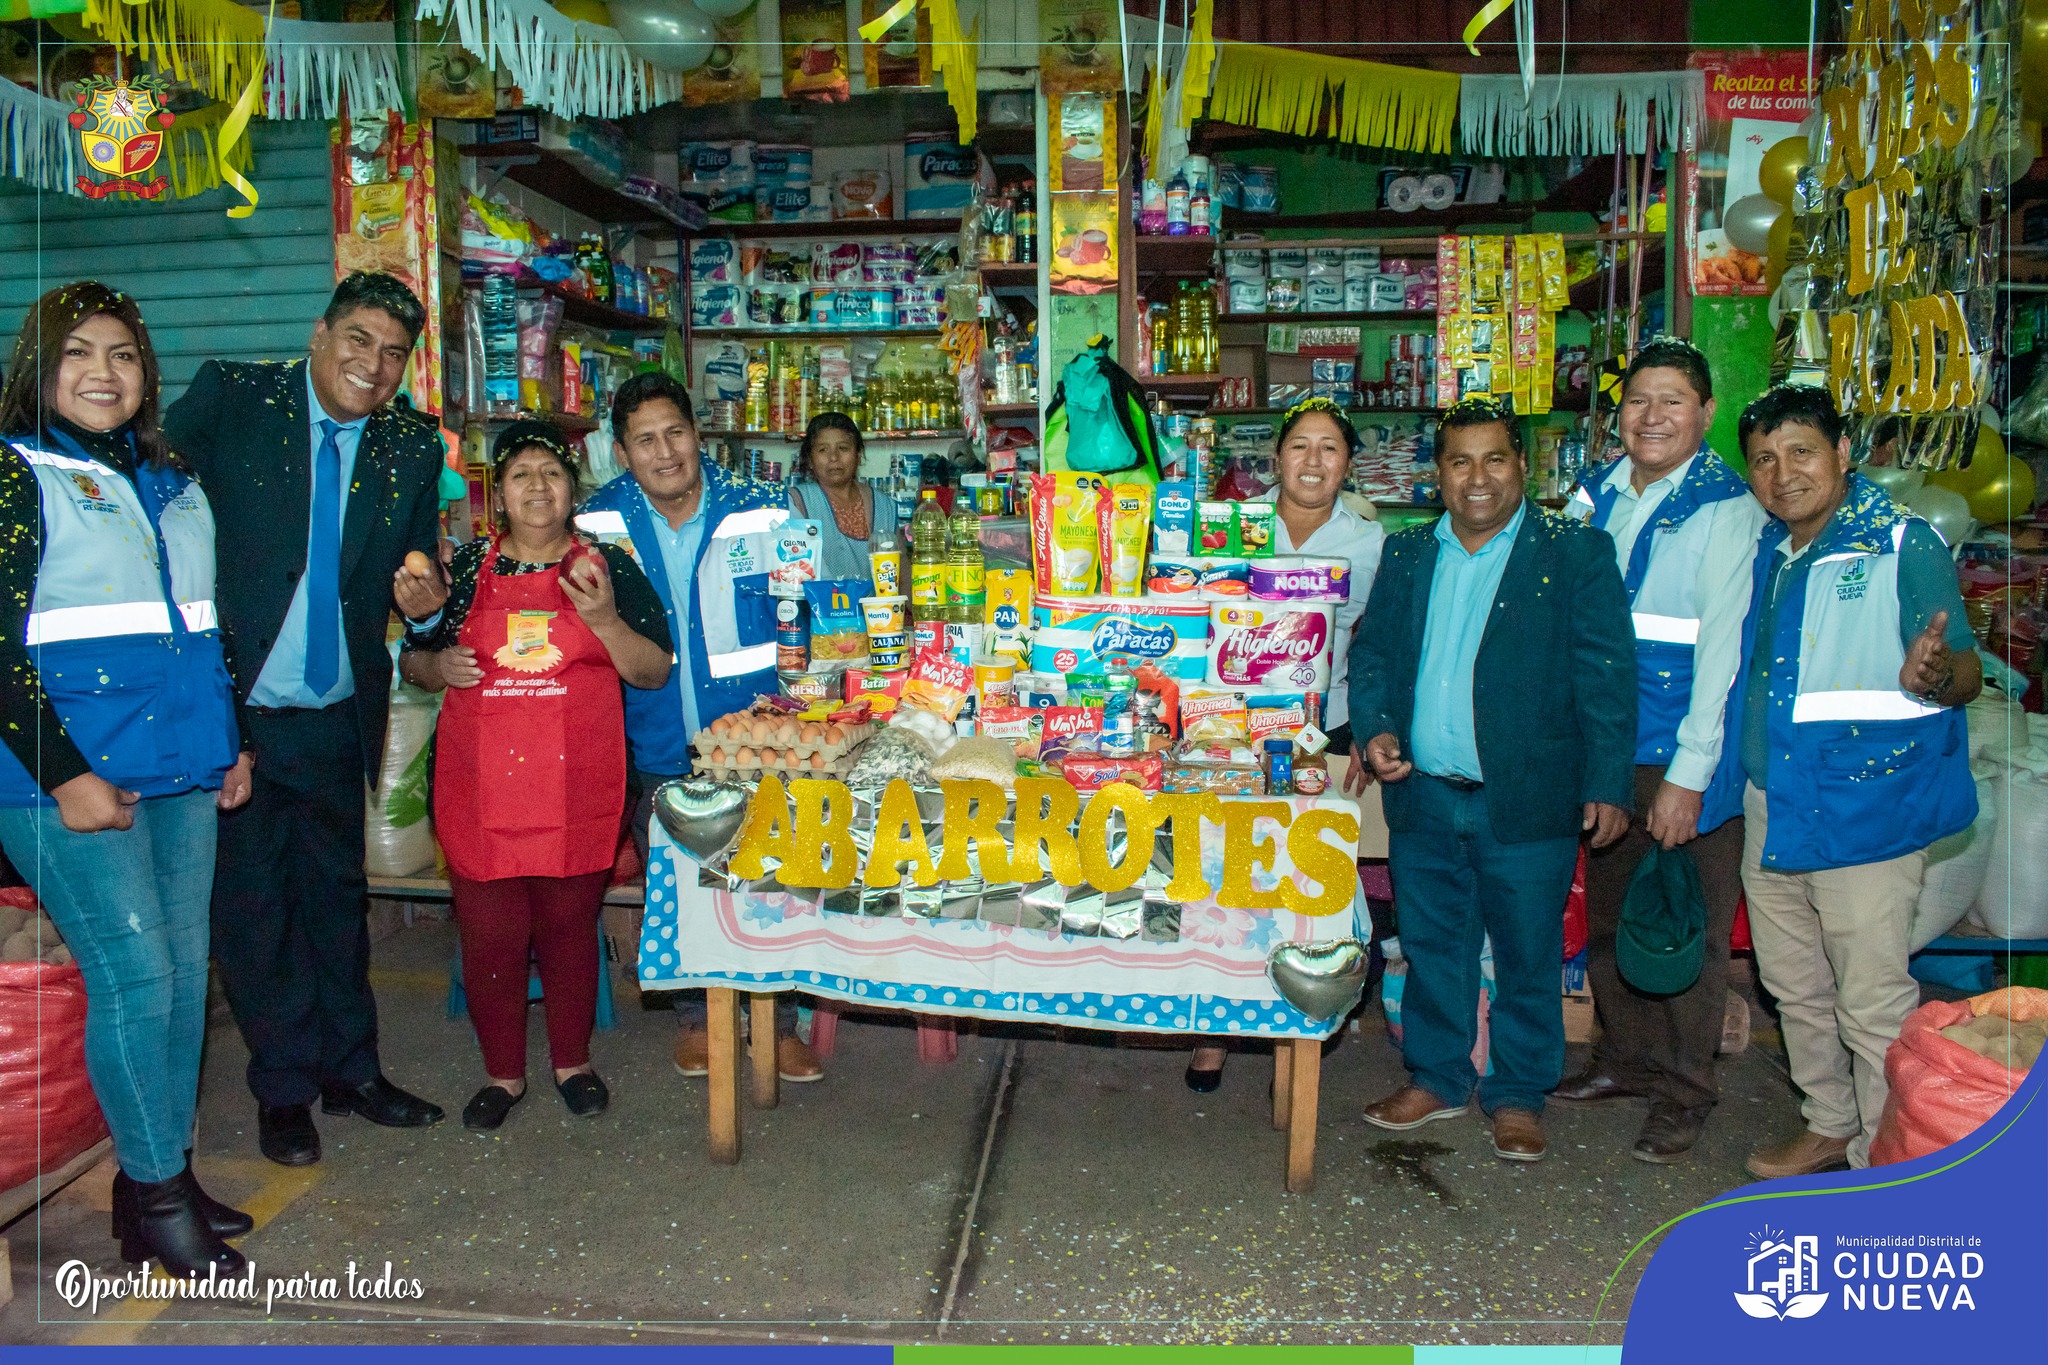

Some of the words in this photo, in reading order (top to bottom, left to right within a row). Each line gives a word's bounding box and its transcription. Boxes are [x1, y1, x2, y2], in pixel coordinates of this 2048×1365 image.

[1713, 74, 1774, 92] Realza
[1779, 74, 1796, 92] el
[1727, 95, 1747, 109] de
[1750, 96, 1771, 109] tus
[697, 151, 728, 166] Elite
[776, 192, 807, 206] Elite
[1376, 284, 1398, 293] tess
[1829, 290, 1974, 415] PLATA
[1034, 496, 1048, 561] AlaCena
[783, 540, 807, 548] GLORIA
[1201, 570, 1229, 584] Suave
[1274, 576, 1328, 591] NOBLE
[1837, 585, 1866, 595] CIUDAD
[1839, 592, 1863, 602] NUEVA
[1052, 613, 1064, 625] 14
[1246, 612, 1255, 622] 8
[873, 637, 905, 648] CALANA
[1097, 624, 1171, 651] Paracas
[1227, 628, 1319, 660] Higienol
[1055, 653, 1076, 666] 25
[494, 677, 514, 687] más
[861, 676, 890, 690] Batán
[1290, 668, 1315, 685] 40
[482, 687, 500, 697] más
[502, 687, 526, 697] sabor
[535, 686, 567, 697] Gallina!
[1050, 713, 1094, 738] Umsha
[1093, 769, 1120, 785] Soda
[728, 774, 1361, 918] ABARROTES
